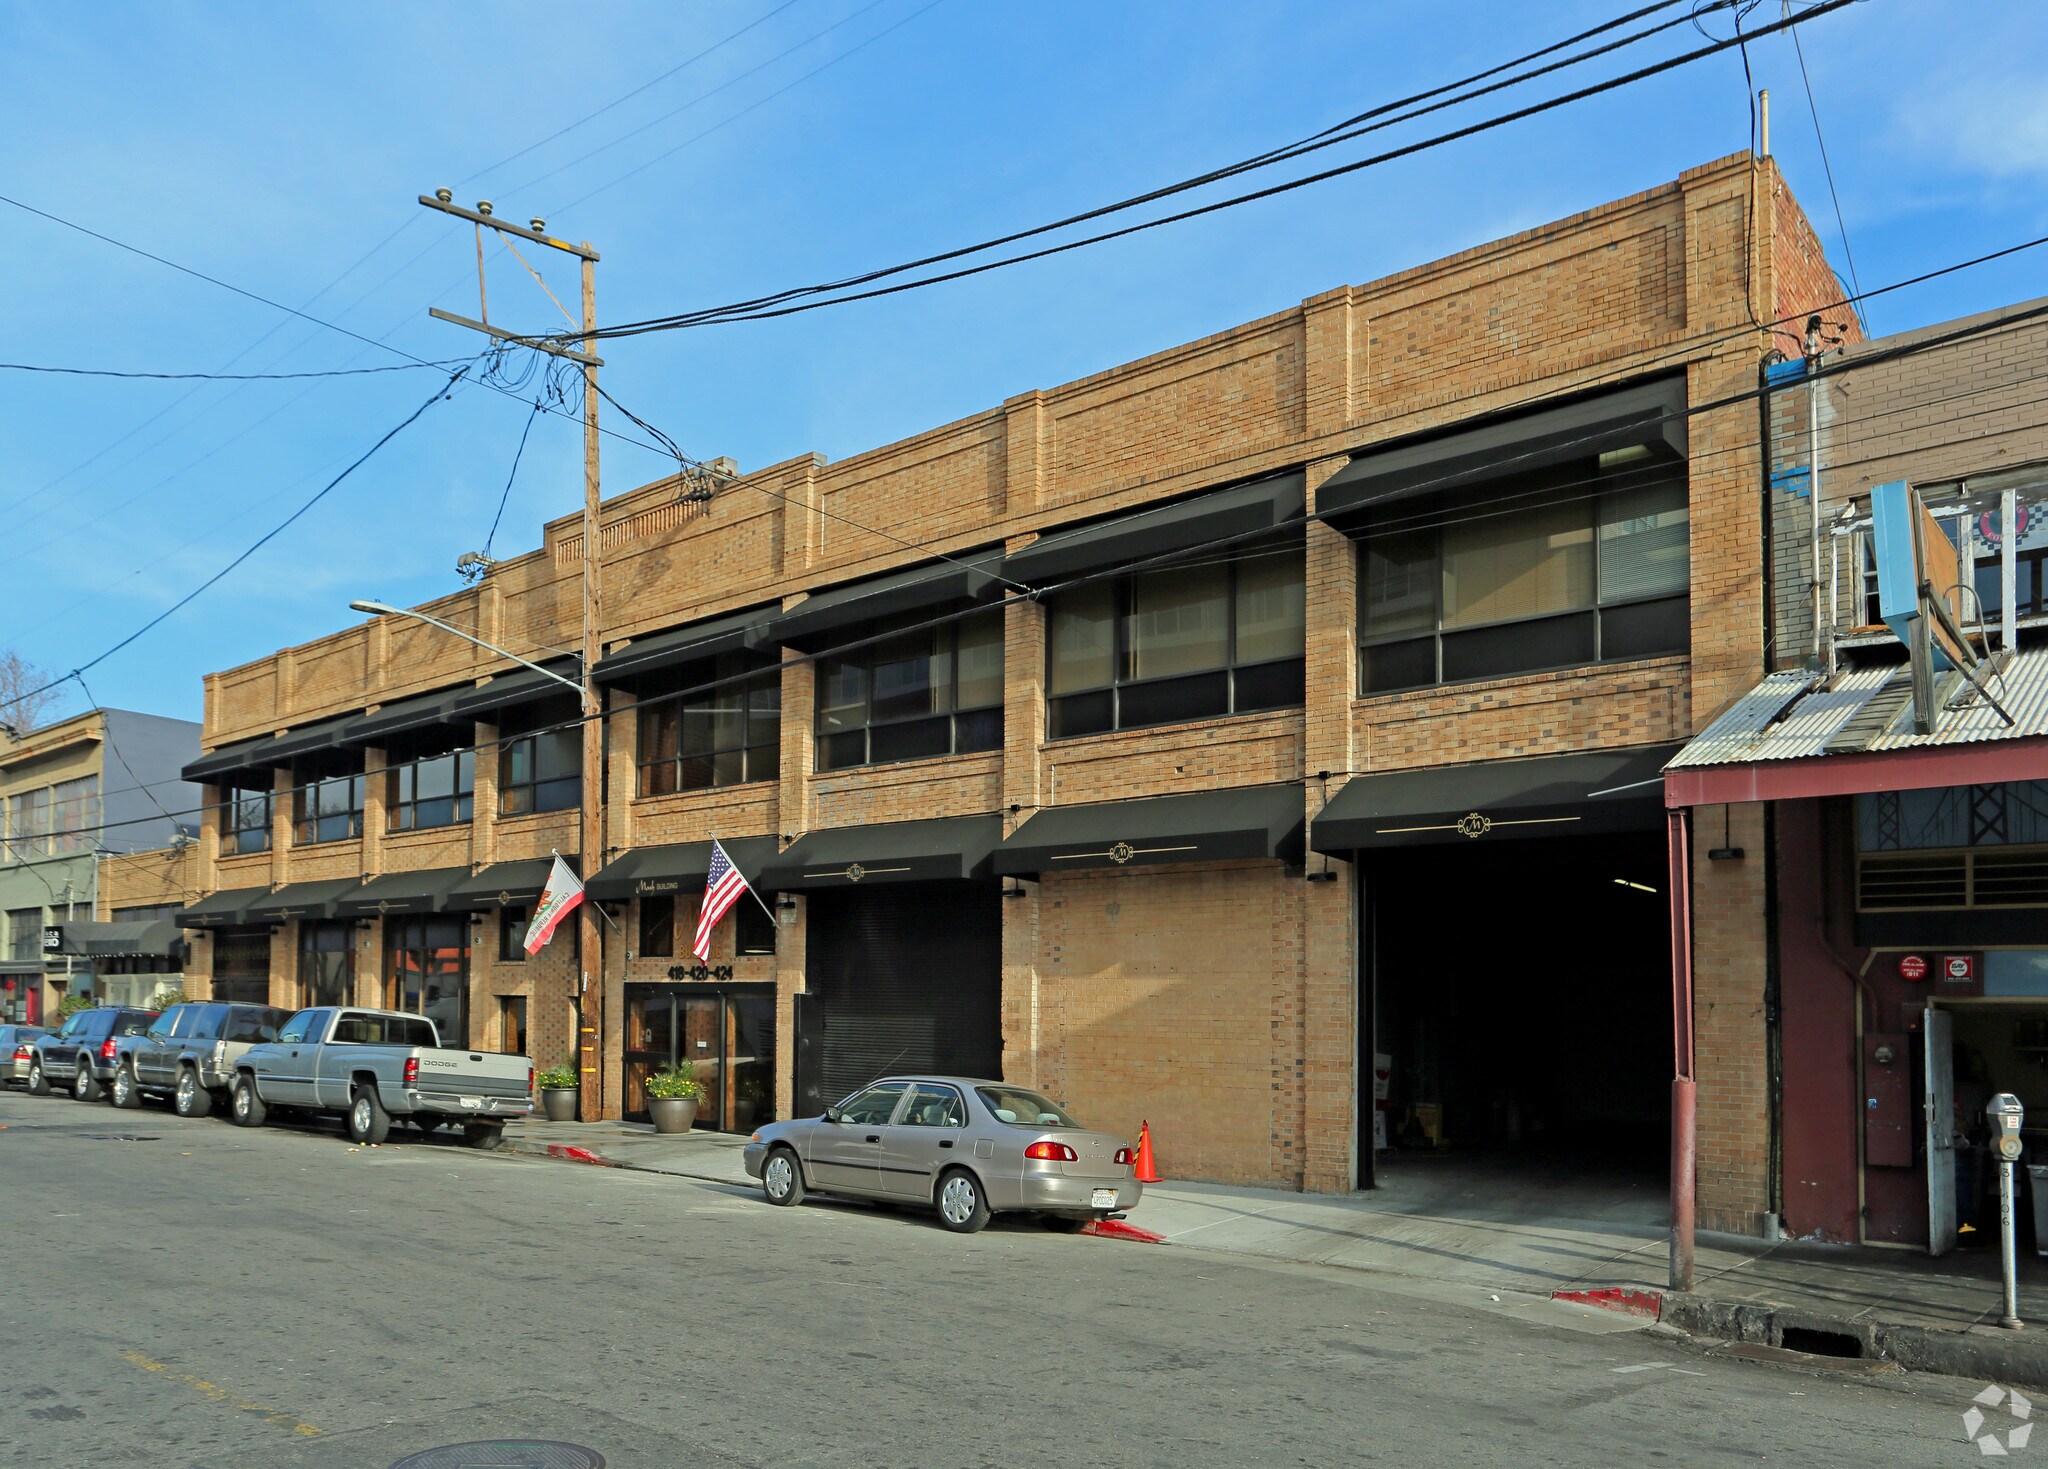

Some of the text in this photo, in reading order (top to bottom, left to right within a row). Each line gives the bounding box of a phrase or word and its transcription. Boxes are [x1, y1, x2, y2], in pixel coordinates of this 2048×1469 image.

[656, 882, 678, 890] BUILDING
[667, 965, 734, 981] 418-420-424
[423, 1060, 458, 1068] DODGE
